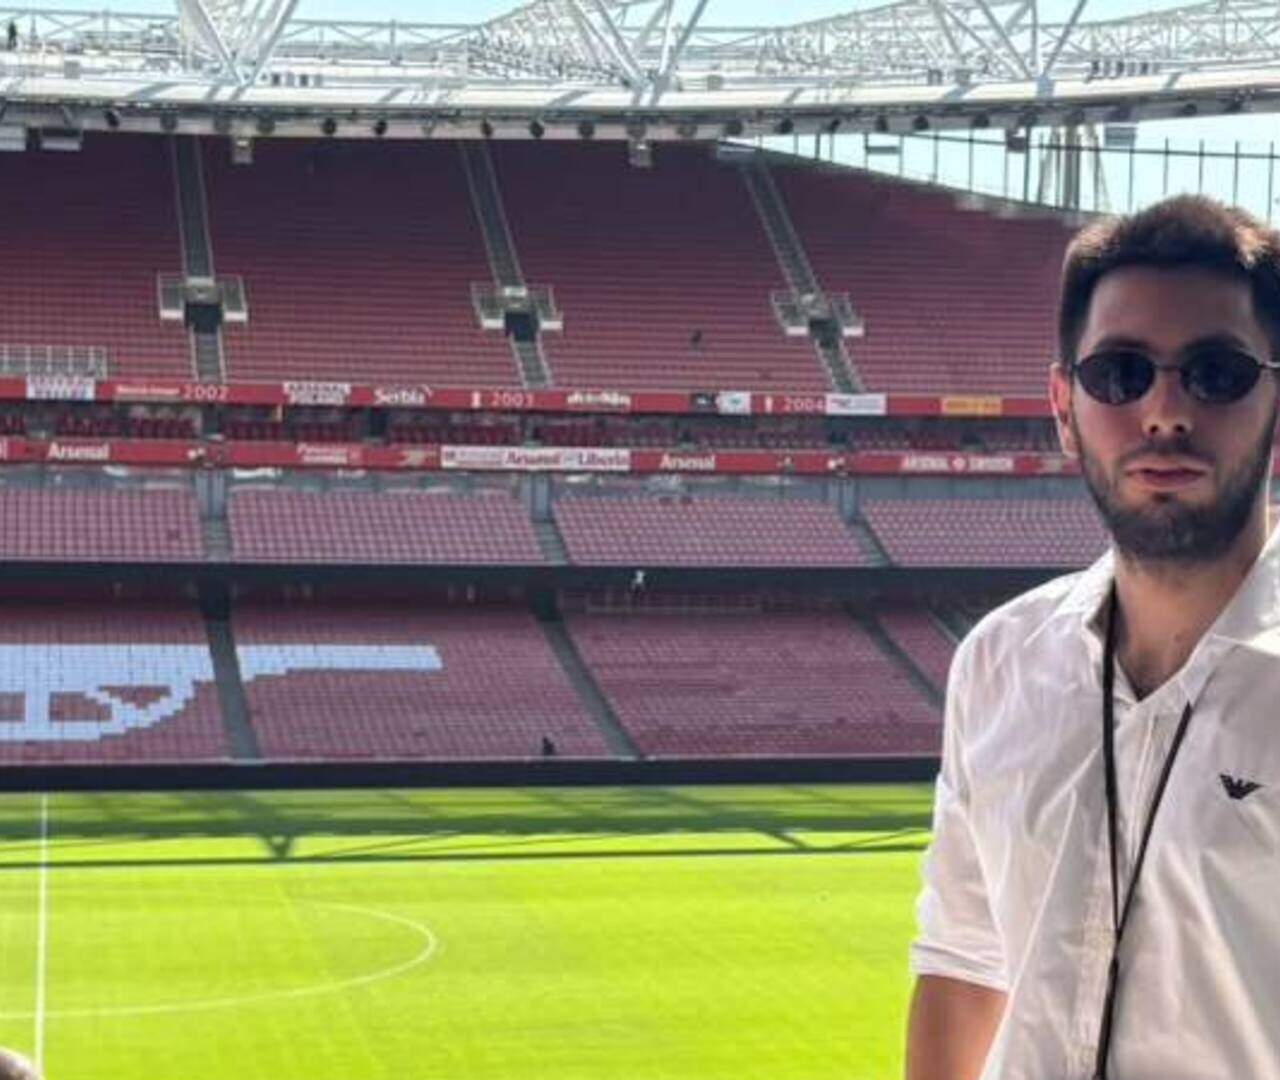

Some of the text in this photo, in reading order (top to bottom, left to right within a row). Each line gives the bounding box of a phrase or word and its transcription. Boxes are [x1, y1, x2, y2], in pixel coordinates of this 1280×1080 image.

[183, 384, 228, 400] 2002
[47, 441, 109, 459] Arsenal
[659, 453, 716, 470] Arsenal
